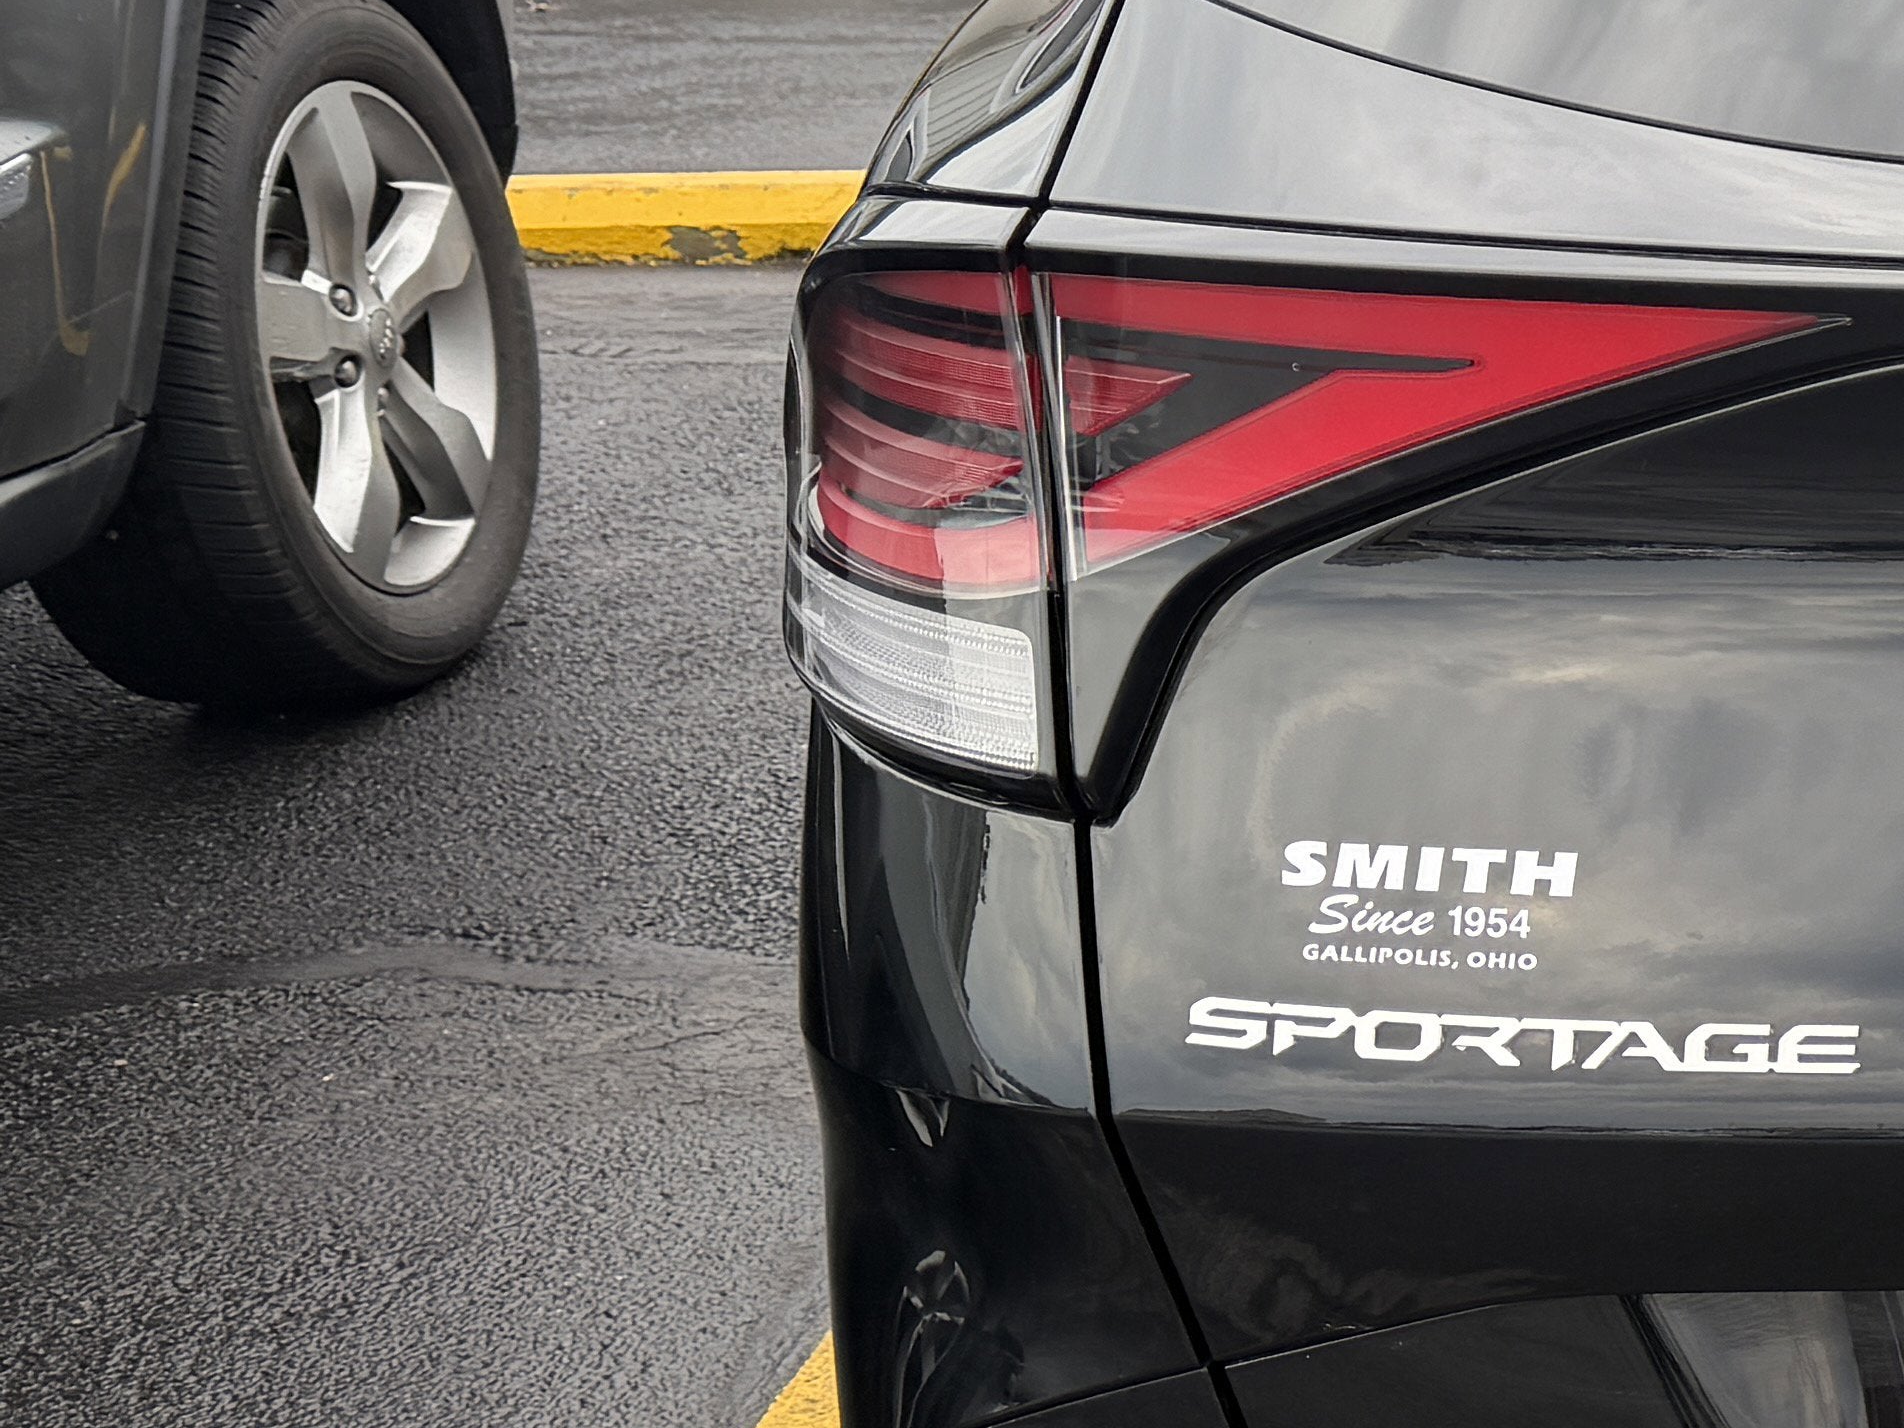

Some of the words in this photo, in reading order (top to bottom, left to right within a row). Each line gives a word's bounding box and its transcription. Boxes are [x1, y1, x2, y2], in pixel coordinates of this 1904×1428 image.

[1281, 840, 1579, 897] SMITH
[1308, 893, 1435, 936] Since
[1448, 905, 1531, 939] 1954
[1302, 943, 1459, 970] GALLIPOLIS,
[1466, 951, 1538, 971] OHIO
[1184, 996, 1861, 1075] SPORTAGE
